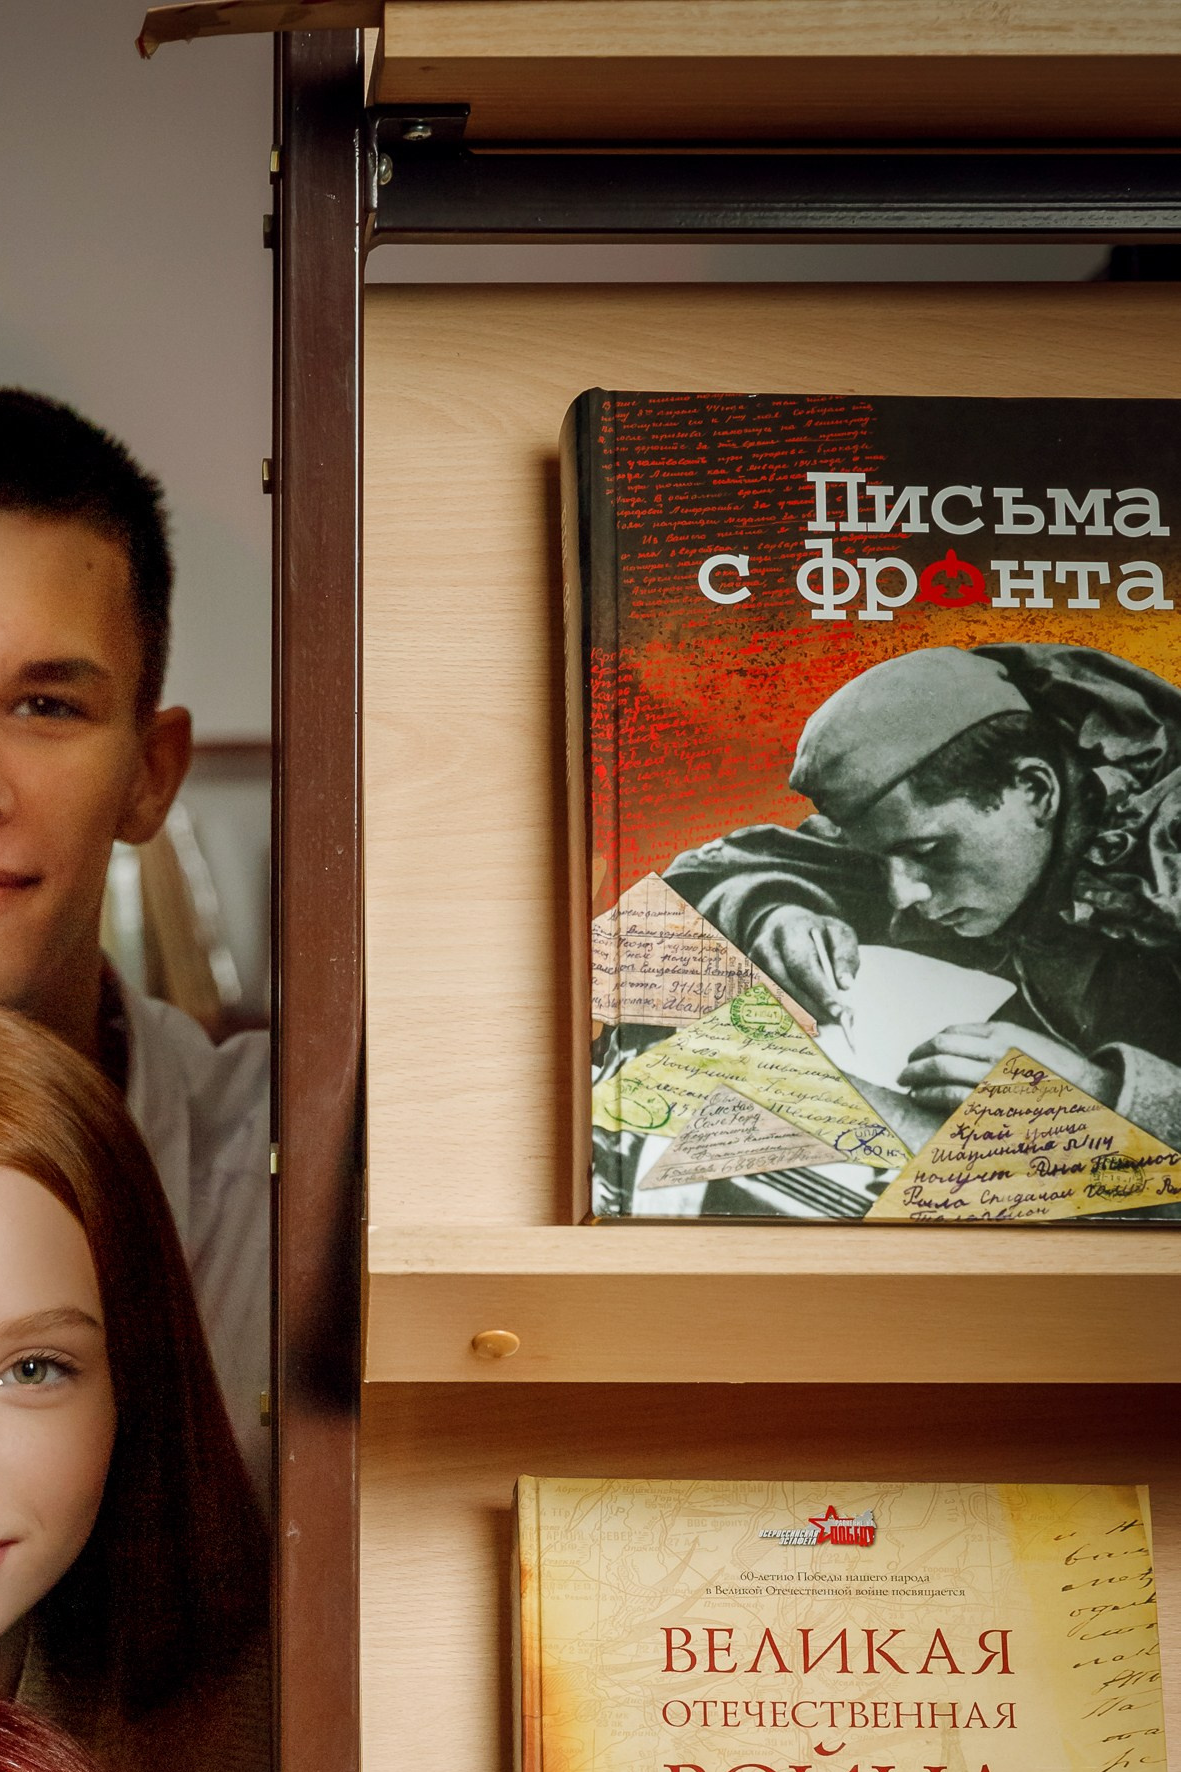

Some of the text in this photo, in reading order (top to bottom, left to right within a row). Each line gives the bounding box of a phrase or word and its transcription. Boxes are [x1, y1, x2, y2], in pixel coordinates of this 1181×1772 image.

[807, 471, 1171, 538] Письма
[697, 551, 753, 606] с
[715, 1585, 763, 1596] Великой
[765, 1585, 852, 1597] Отечественной
[855, 1586, 889, 1597] войне
[891, 1587, 967, 1599] посвящается
[739, 1571, 931, 1586] 60-летию Победы нашего народа
[660, 1625, 1017, 1676] ВЕЛИКАЯ
[661, 1699, 1019, 1730] ОТЕЧЕСТВЕННАЯ
